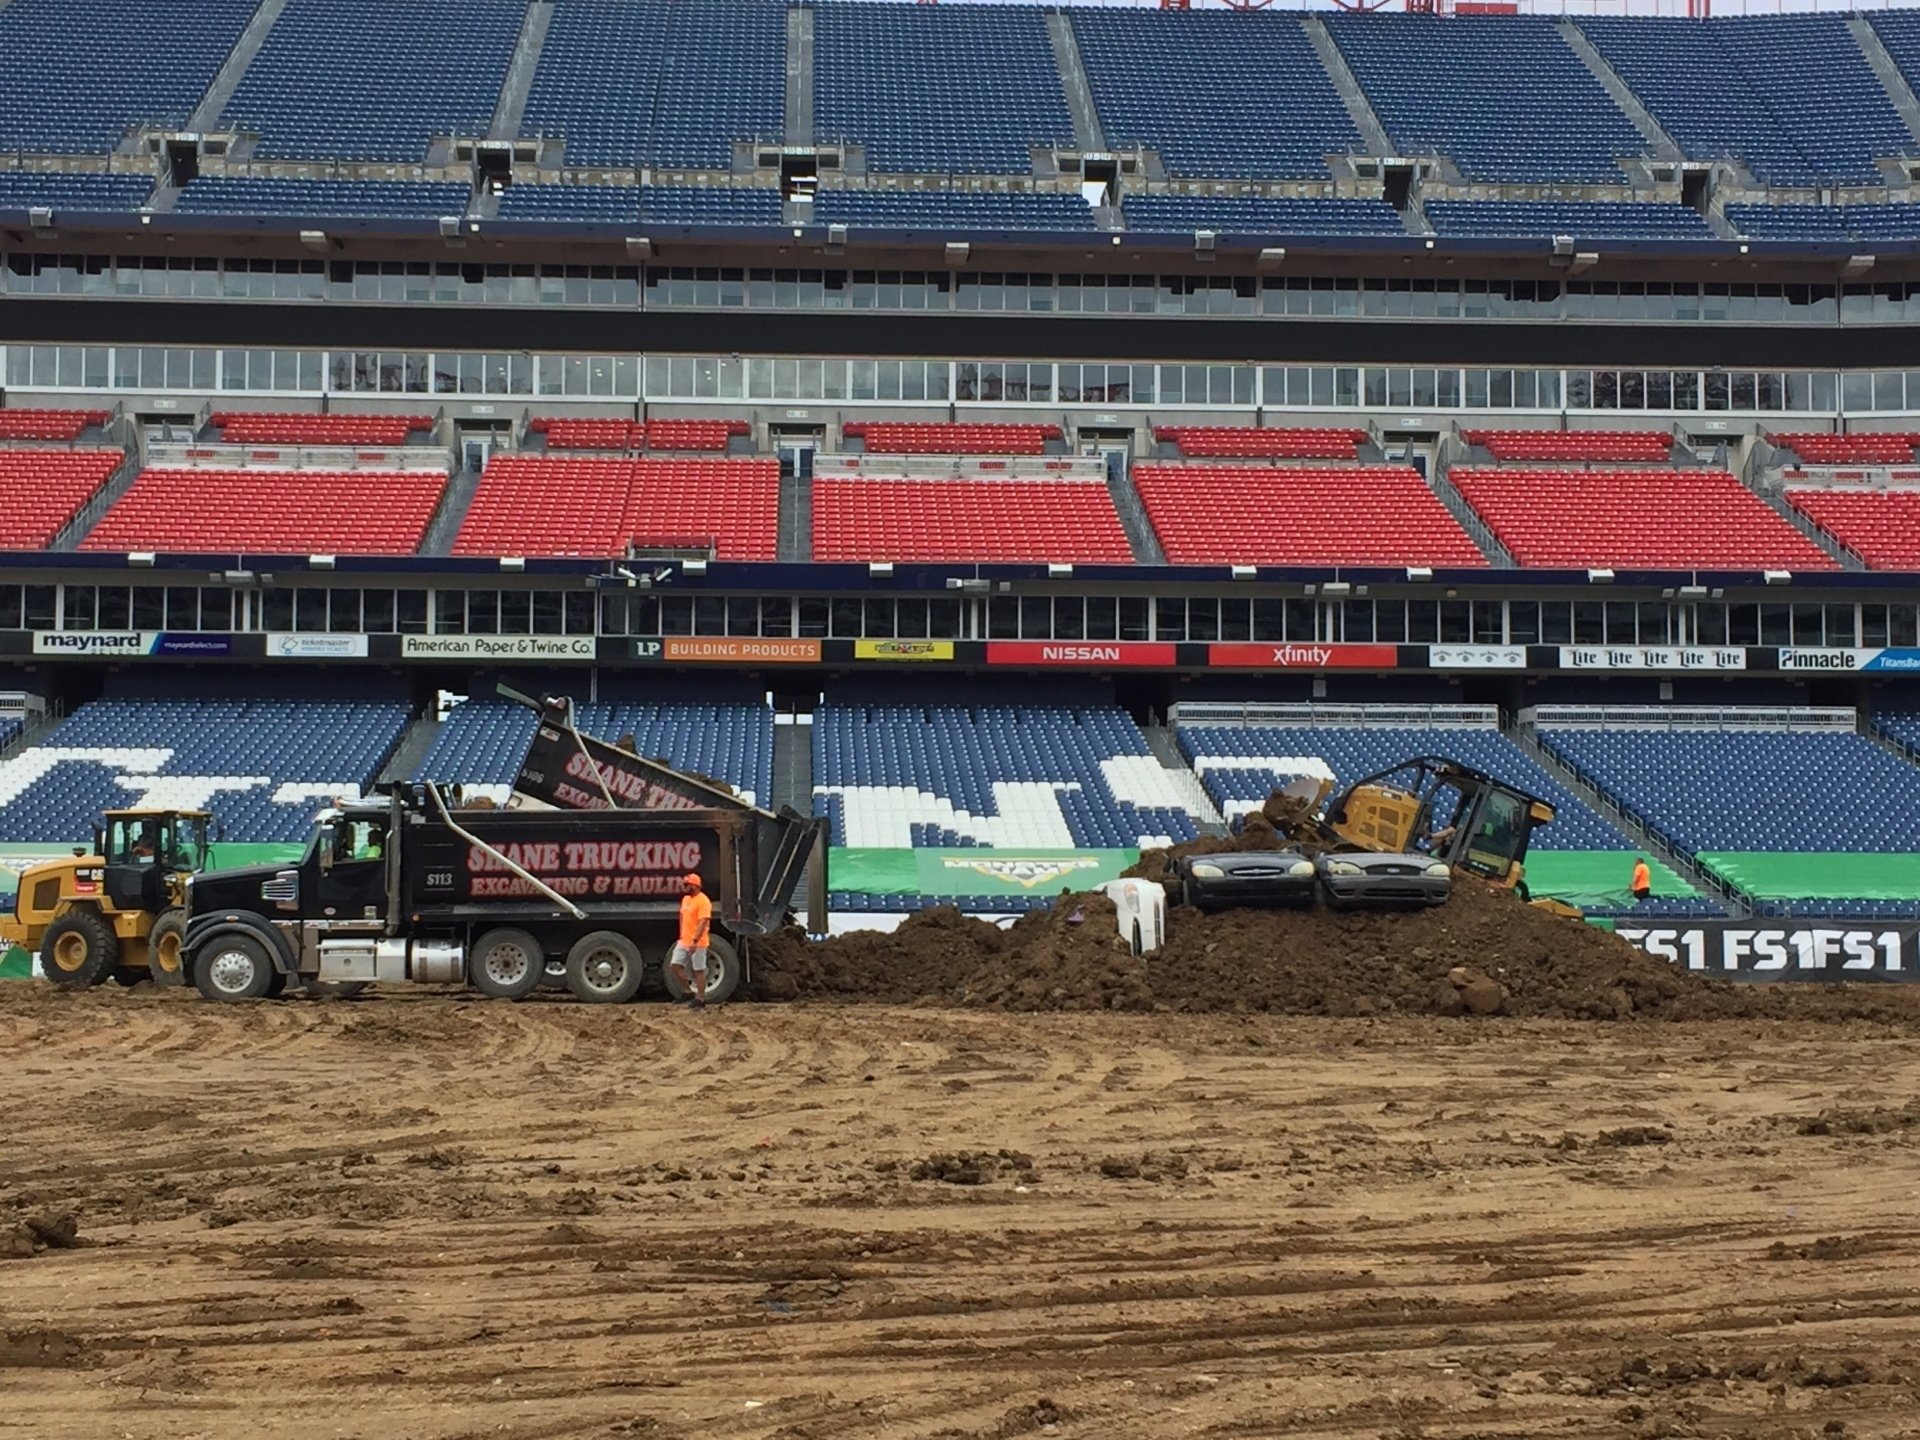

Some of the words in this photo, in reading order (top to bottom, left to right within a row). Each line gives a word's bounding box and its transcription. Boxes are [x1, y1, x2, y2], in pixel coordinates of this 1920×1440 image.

[43, 633, 141, 650] maynard
[407, 638, 470, 652] American
[475, 639, 514, 655] Paper
[517, 639, 528, 653] &
[530, 639, 567, 653] Twine
[571, 640, 592, 654] Co.
[637, 642, 661, 656] LP
[671, 643, 737, 655] BUILDING
[742, 644, 816, 656] PRODUCTS
[1043, 647, 1120, 660] NISSAN
[1273, 645, 1332, 666] xfinity
[1568, 650, 1597, 667] Lite
[1604, 650, 1633, 667] Lite
[1641, 650, 1669, 667] Lite
[1677, 650, 1704, 668] Lite
[1713, 651, 1741, 668] Lite
[1781, 650, 1855, 668] Pinnacle
[566, 752, 647, 801] SHANE
[468, 841, 560, 872] SHANE
[565, 841, 701, 872] TRUCKING
[427, 873, 453, 886] S113
[592, 875, 611, 894] &
[614, 876, 689, 896] HAULIN
[1723, 929, 1813, 971] FS1
[1813, 929, 1902, 971] FS1
